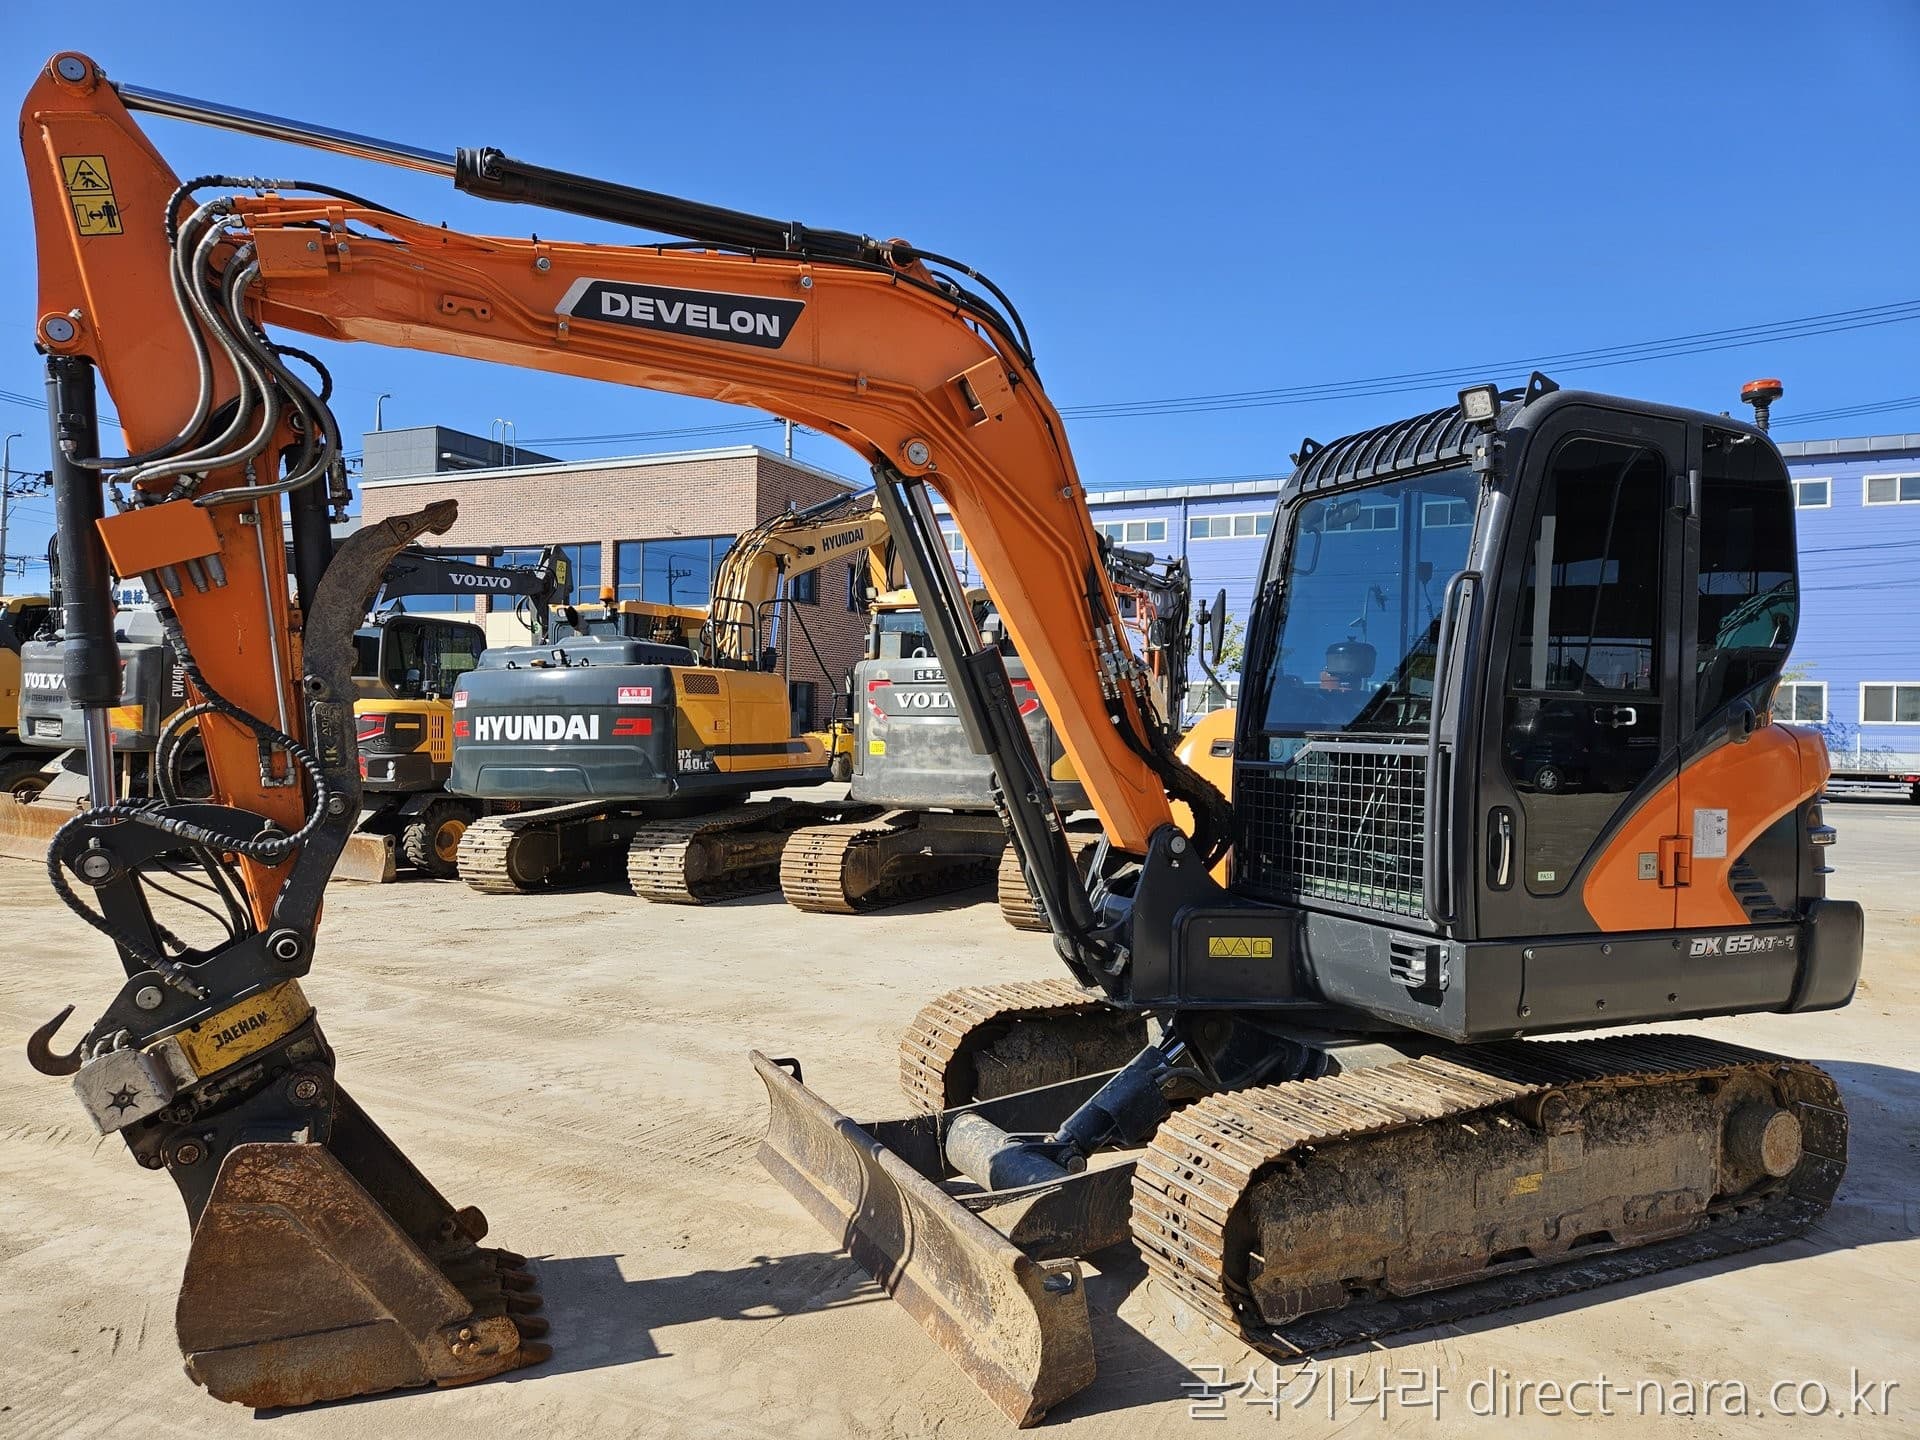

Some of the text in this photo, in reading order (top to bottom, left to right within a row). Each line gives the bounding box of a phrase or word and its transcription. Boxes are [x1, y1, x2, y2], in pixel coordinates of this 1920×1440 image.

[601, 291, 780, 338] DEVELON
[822, 527, 864, 552] HYUNDAI
[449, 573, 512, 589] VOLVO
[24, 672, 67, 689] VOLV
[474, 714, 600, 741] HYUNDAI
[677, 749, 692, 759] HX
[678, 758, 710, 771] 140LC
[1689, 937, 1722, 958] DX
[211, 1010, 269, 1053] JAEHAN
